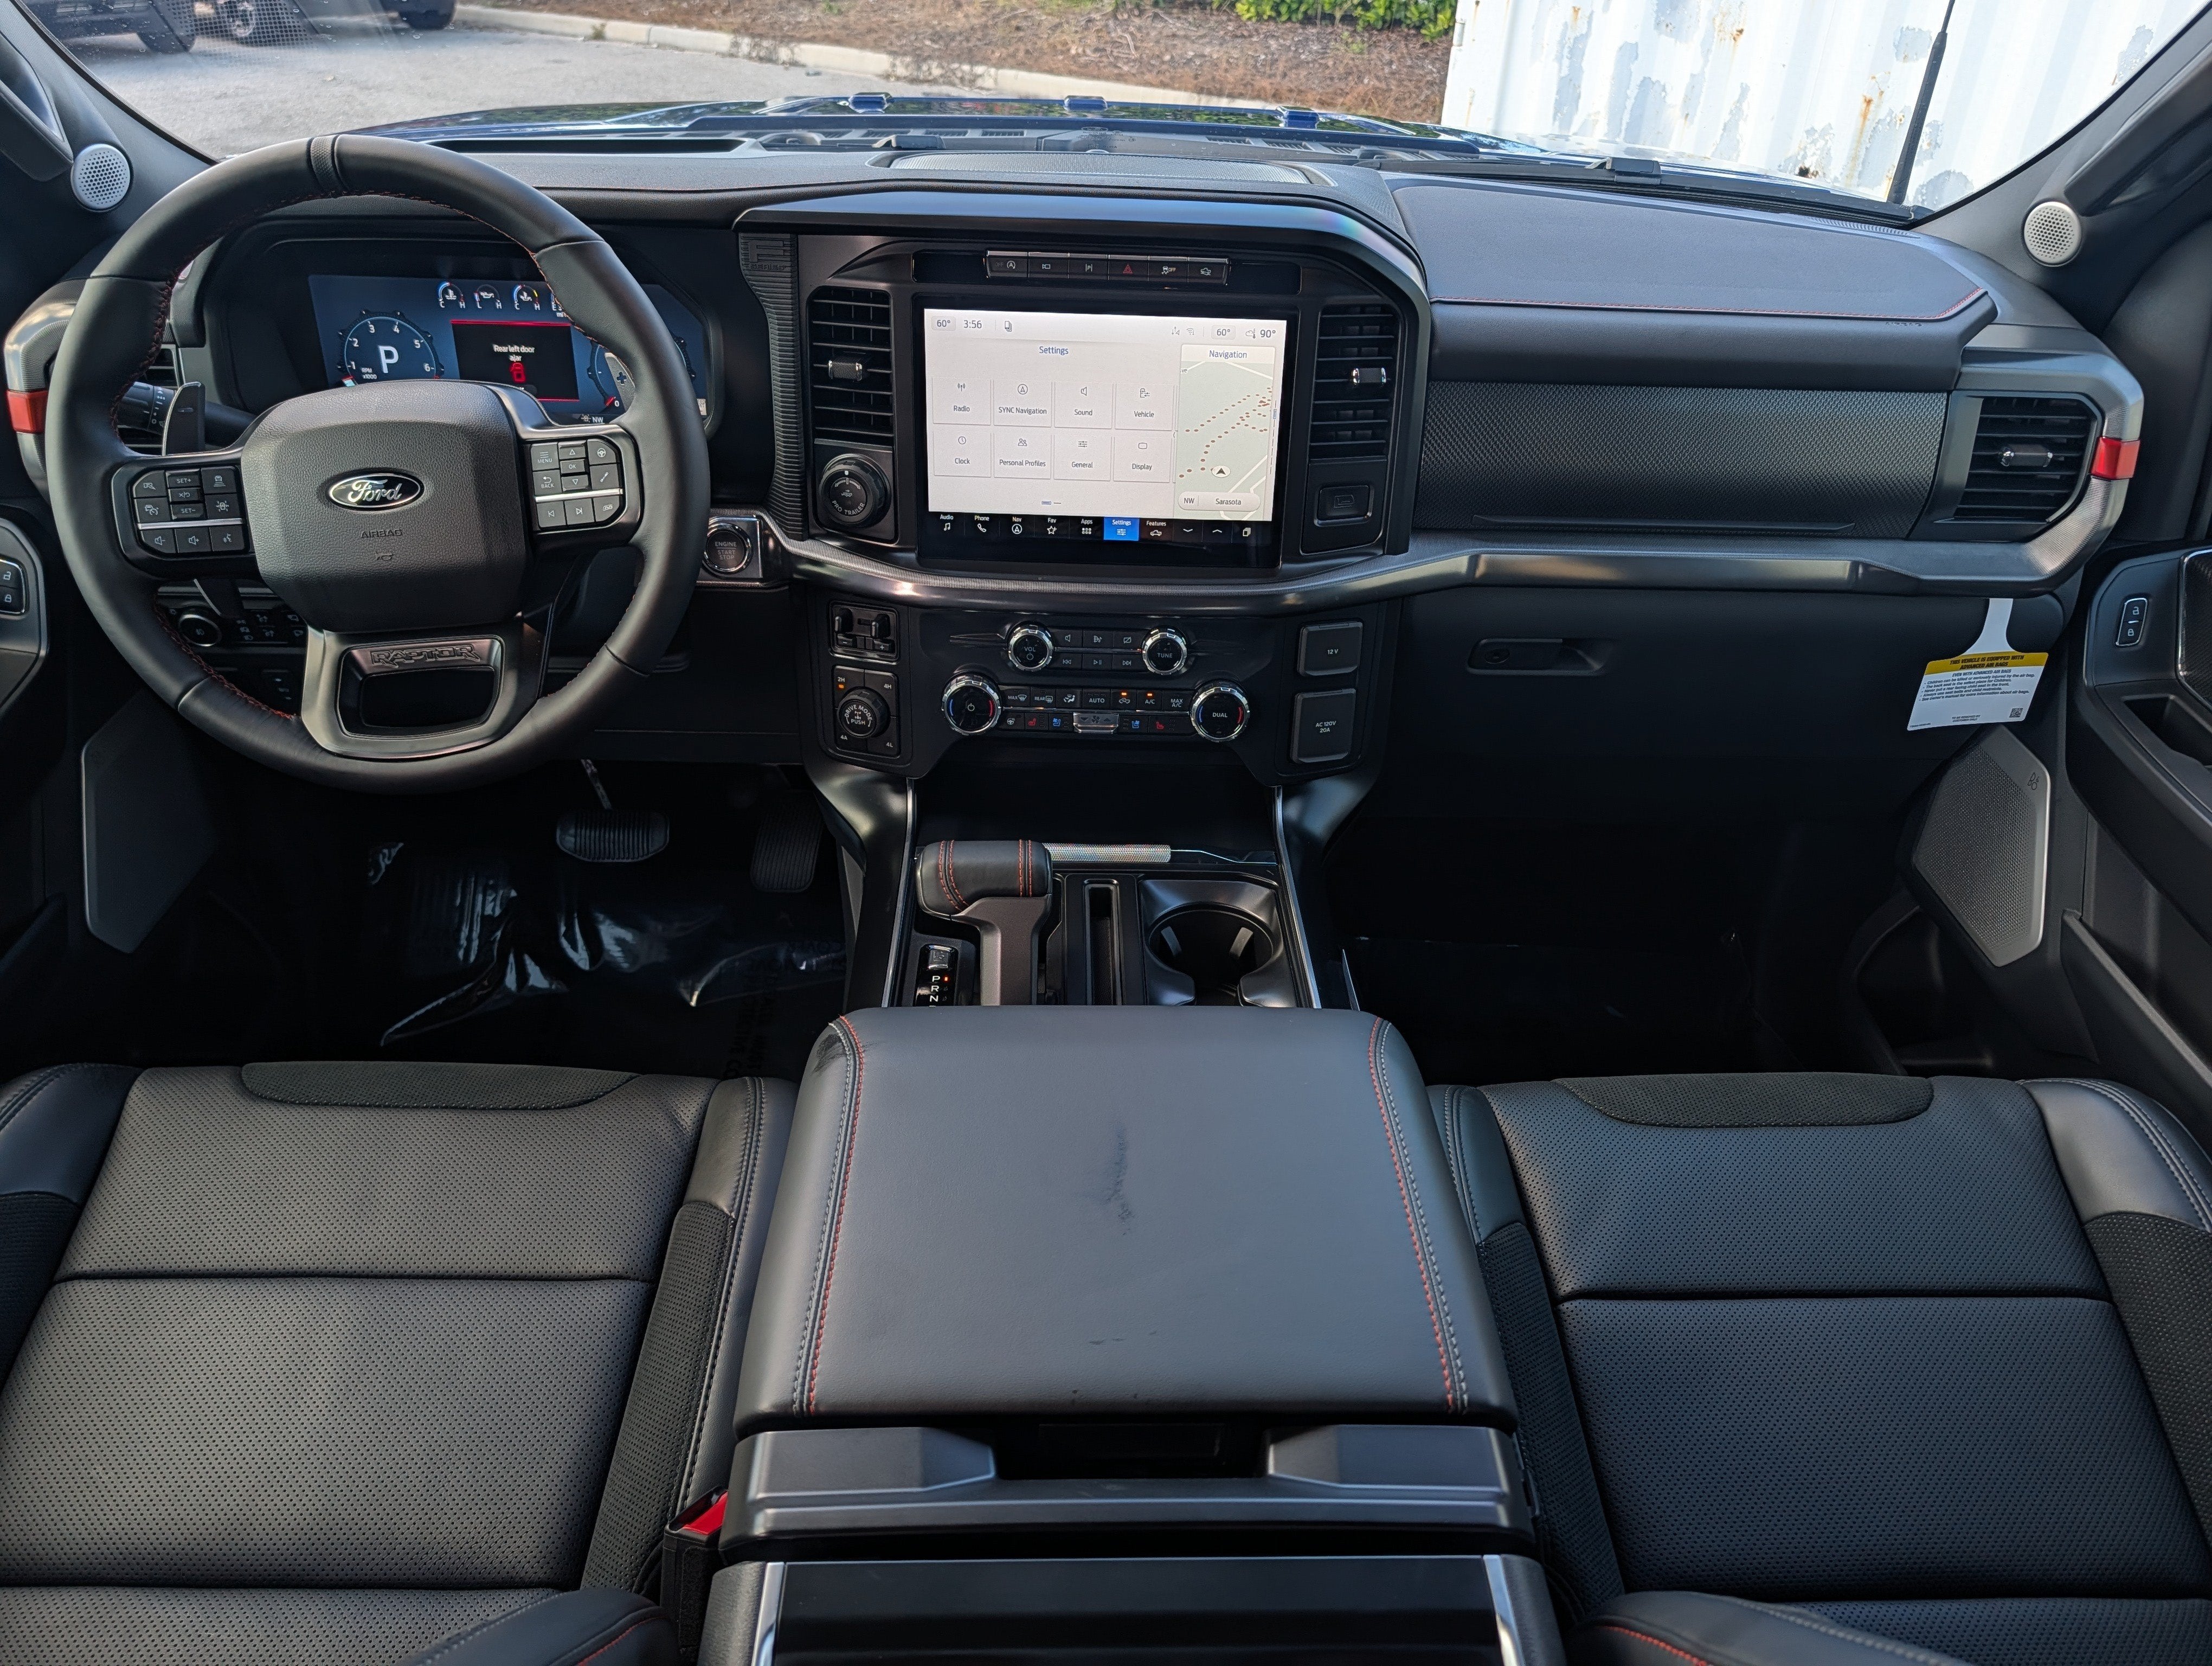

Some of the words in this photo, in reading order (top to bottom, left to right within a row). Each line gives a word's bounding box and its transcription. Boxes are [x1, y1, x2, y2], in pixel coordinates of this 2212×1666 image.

[937, 319, 951, 328] 60°
[964, 320, 982, 329] 3:56
[369, 324, 375, 334] 3
[393, 325, 400, 334] 4
[1217, 328, 1231, 337] 60°
[1260, 329, 1276, 338] 90°
[352, 338, 359, 347] 2
[414, 339, 421, 348] 5
[493, 344, 508, 353] Rear
[1039, 346, 1069, 356] Settings
[1209, 350, 1247, 359] Navigation
[378, 345, 398, 374] P
[350, 361, 356, 369] 1
[424, 363, 430, 372] 6
[1016, 408, 1047, 416] Navigation
[999, 459, 1023, 467] Personal
[1132, 463, 1152, 472] Display
[348, 479, 402, 502] Ford
[832, 501, 843, 512] PRO
[845, 503, 865, 515] TRAILER
[361, 529, 403, 539] AIRBAG
[371, 645, 481, 668] RAPTOR
[844, 704, 857, 718] DRIVE
[859, 706, 873, 721] MODE
